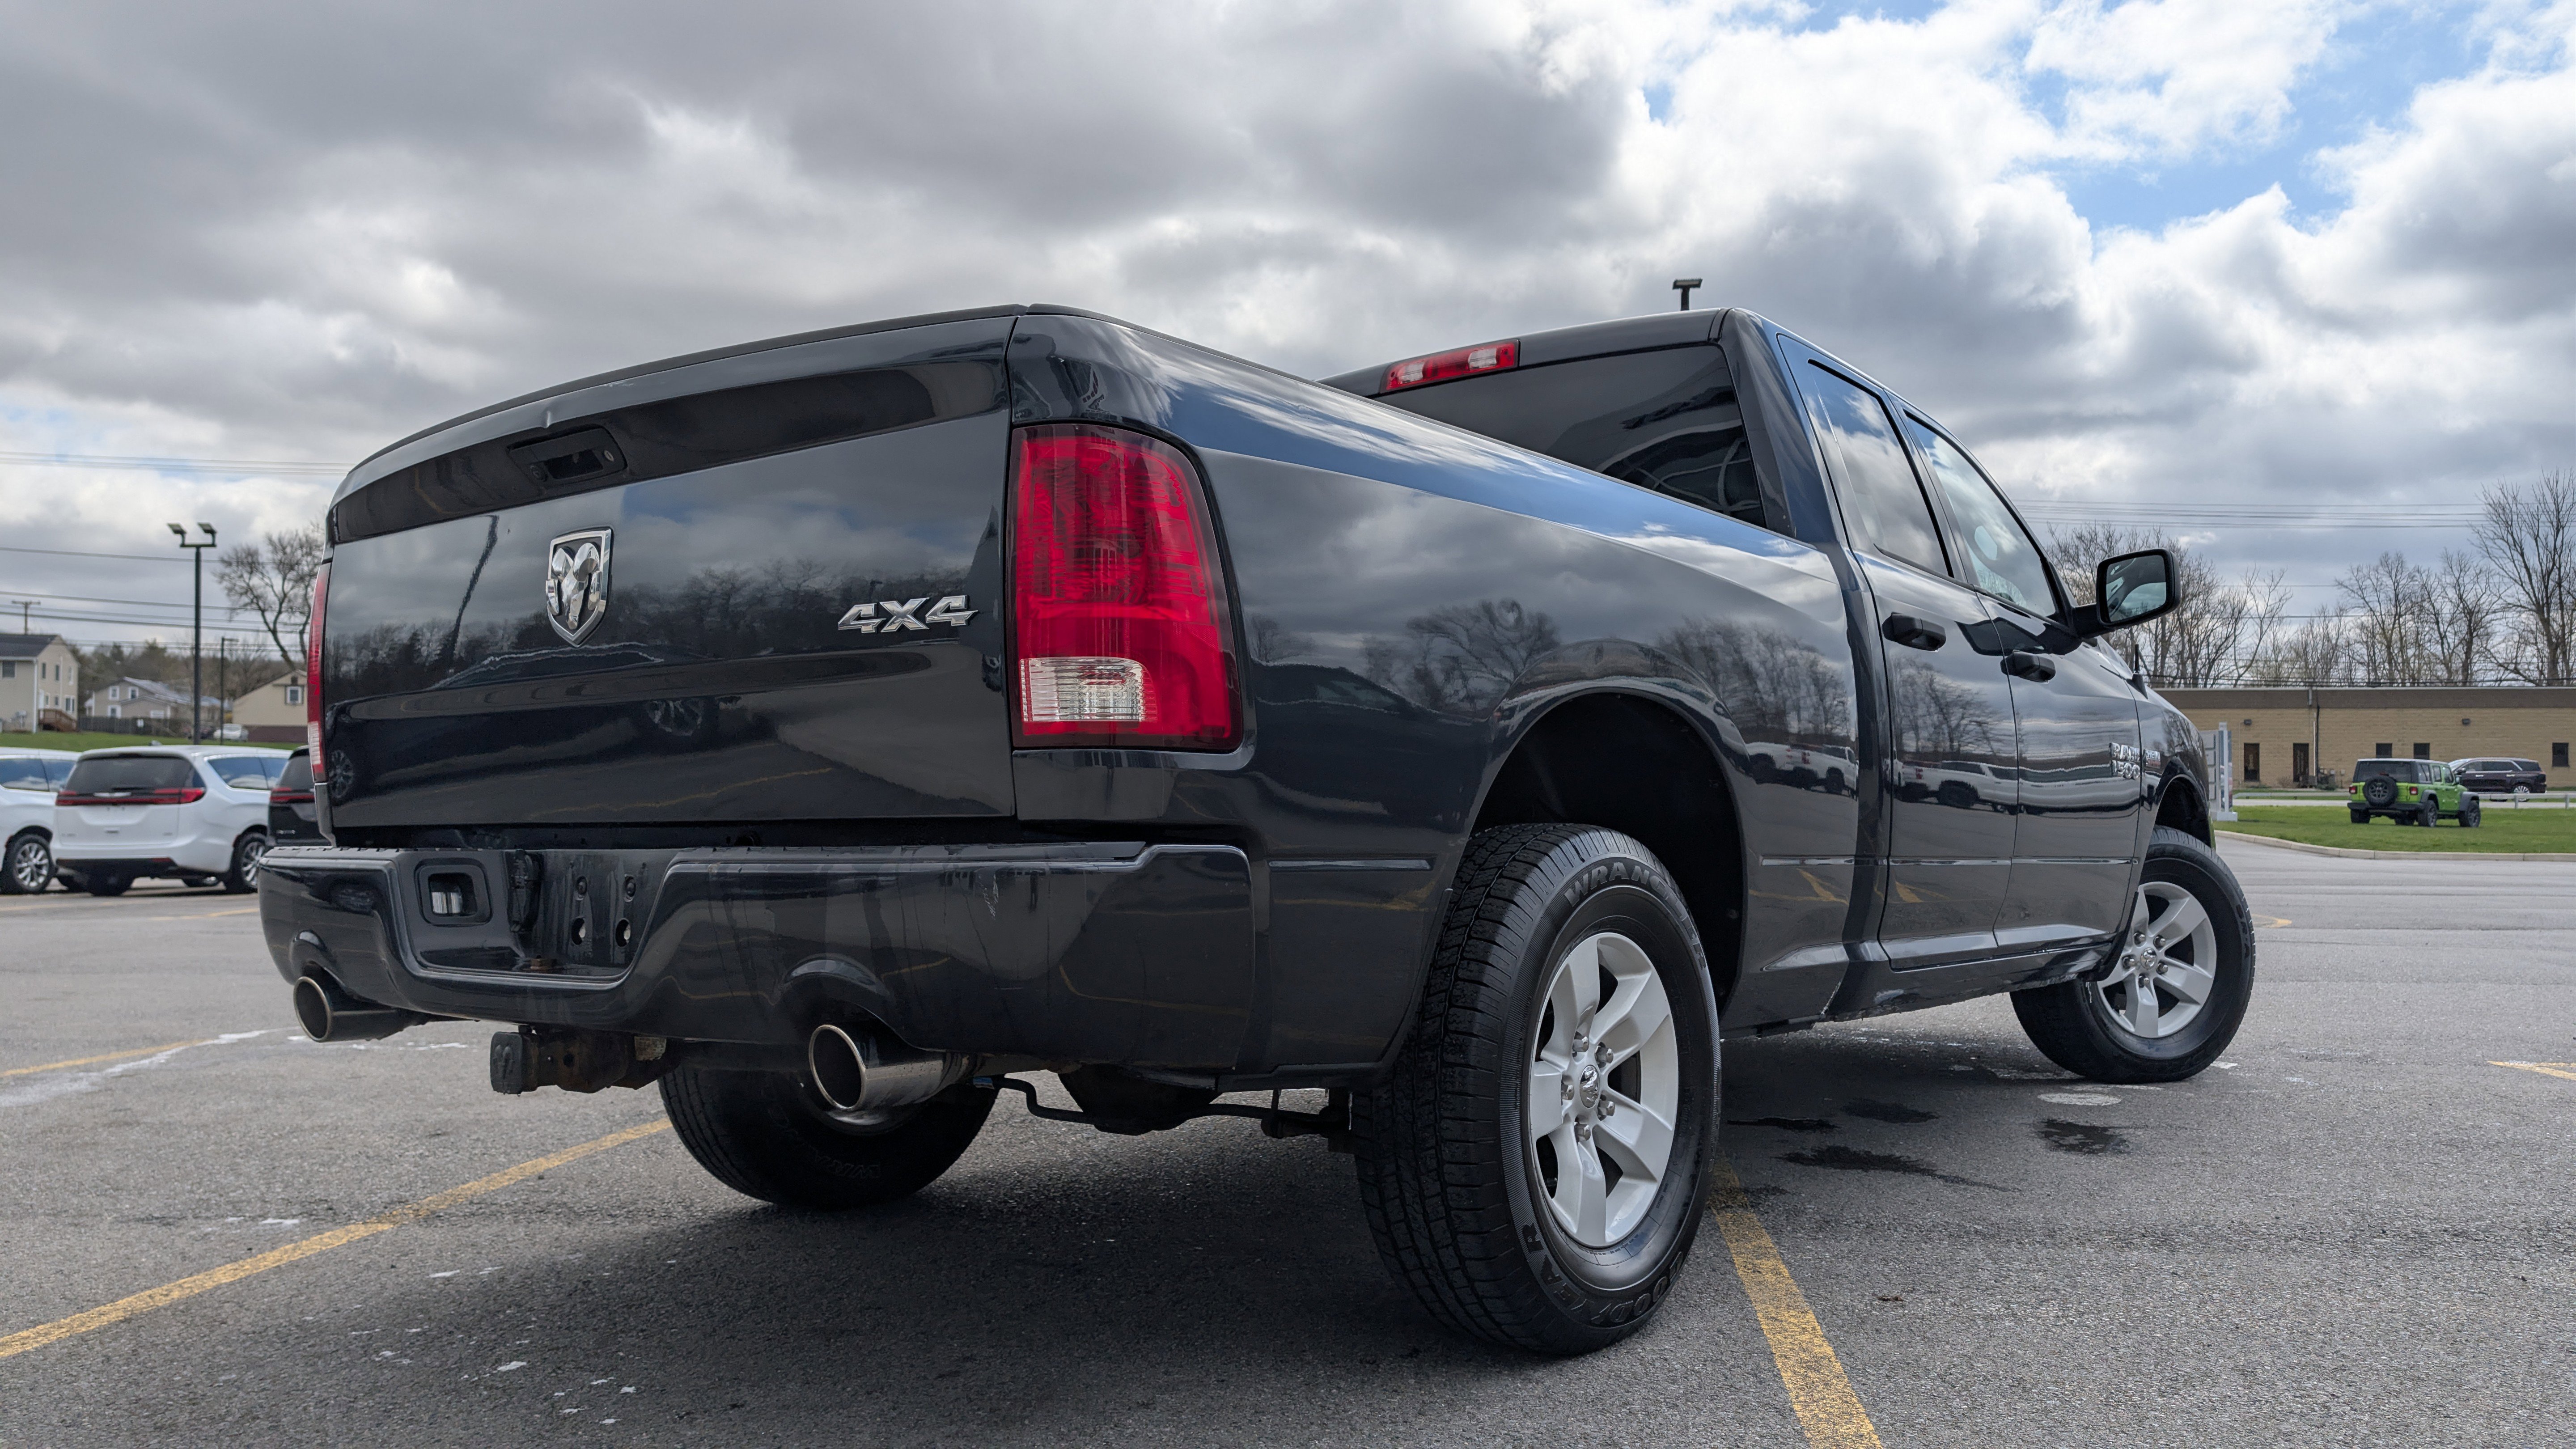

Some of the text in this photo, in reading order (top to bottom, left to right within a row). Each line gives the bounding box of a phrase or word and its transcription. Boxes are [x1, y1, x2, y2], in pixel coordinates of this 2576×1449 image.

[837, 595, 979, 633] 4X4
[2110, 742, 2140, 761] RAM
[2111, 760, 2140, 779] 1500
[1564, 862, 1706, 970] WRANGLER
[1522, 1222, 1684, 1325] GOODYEAR
